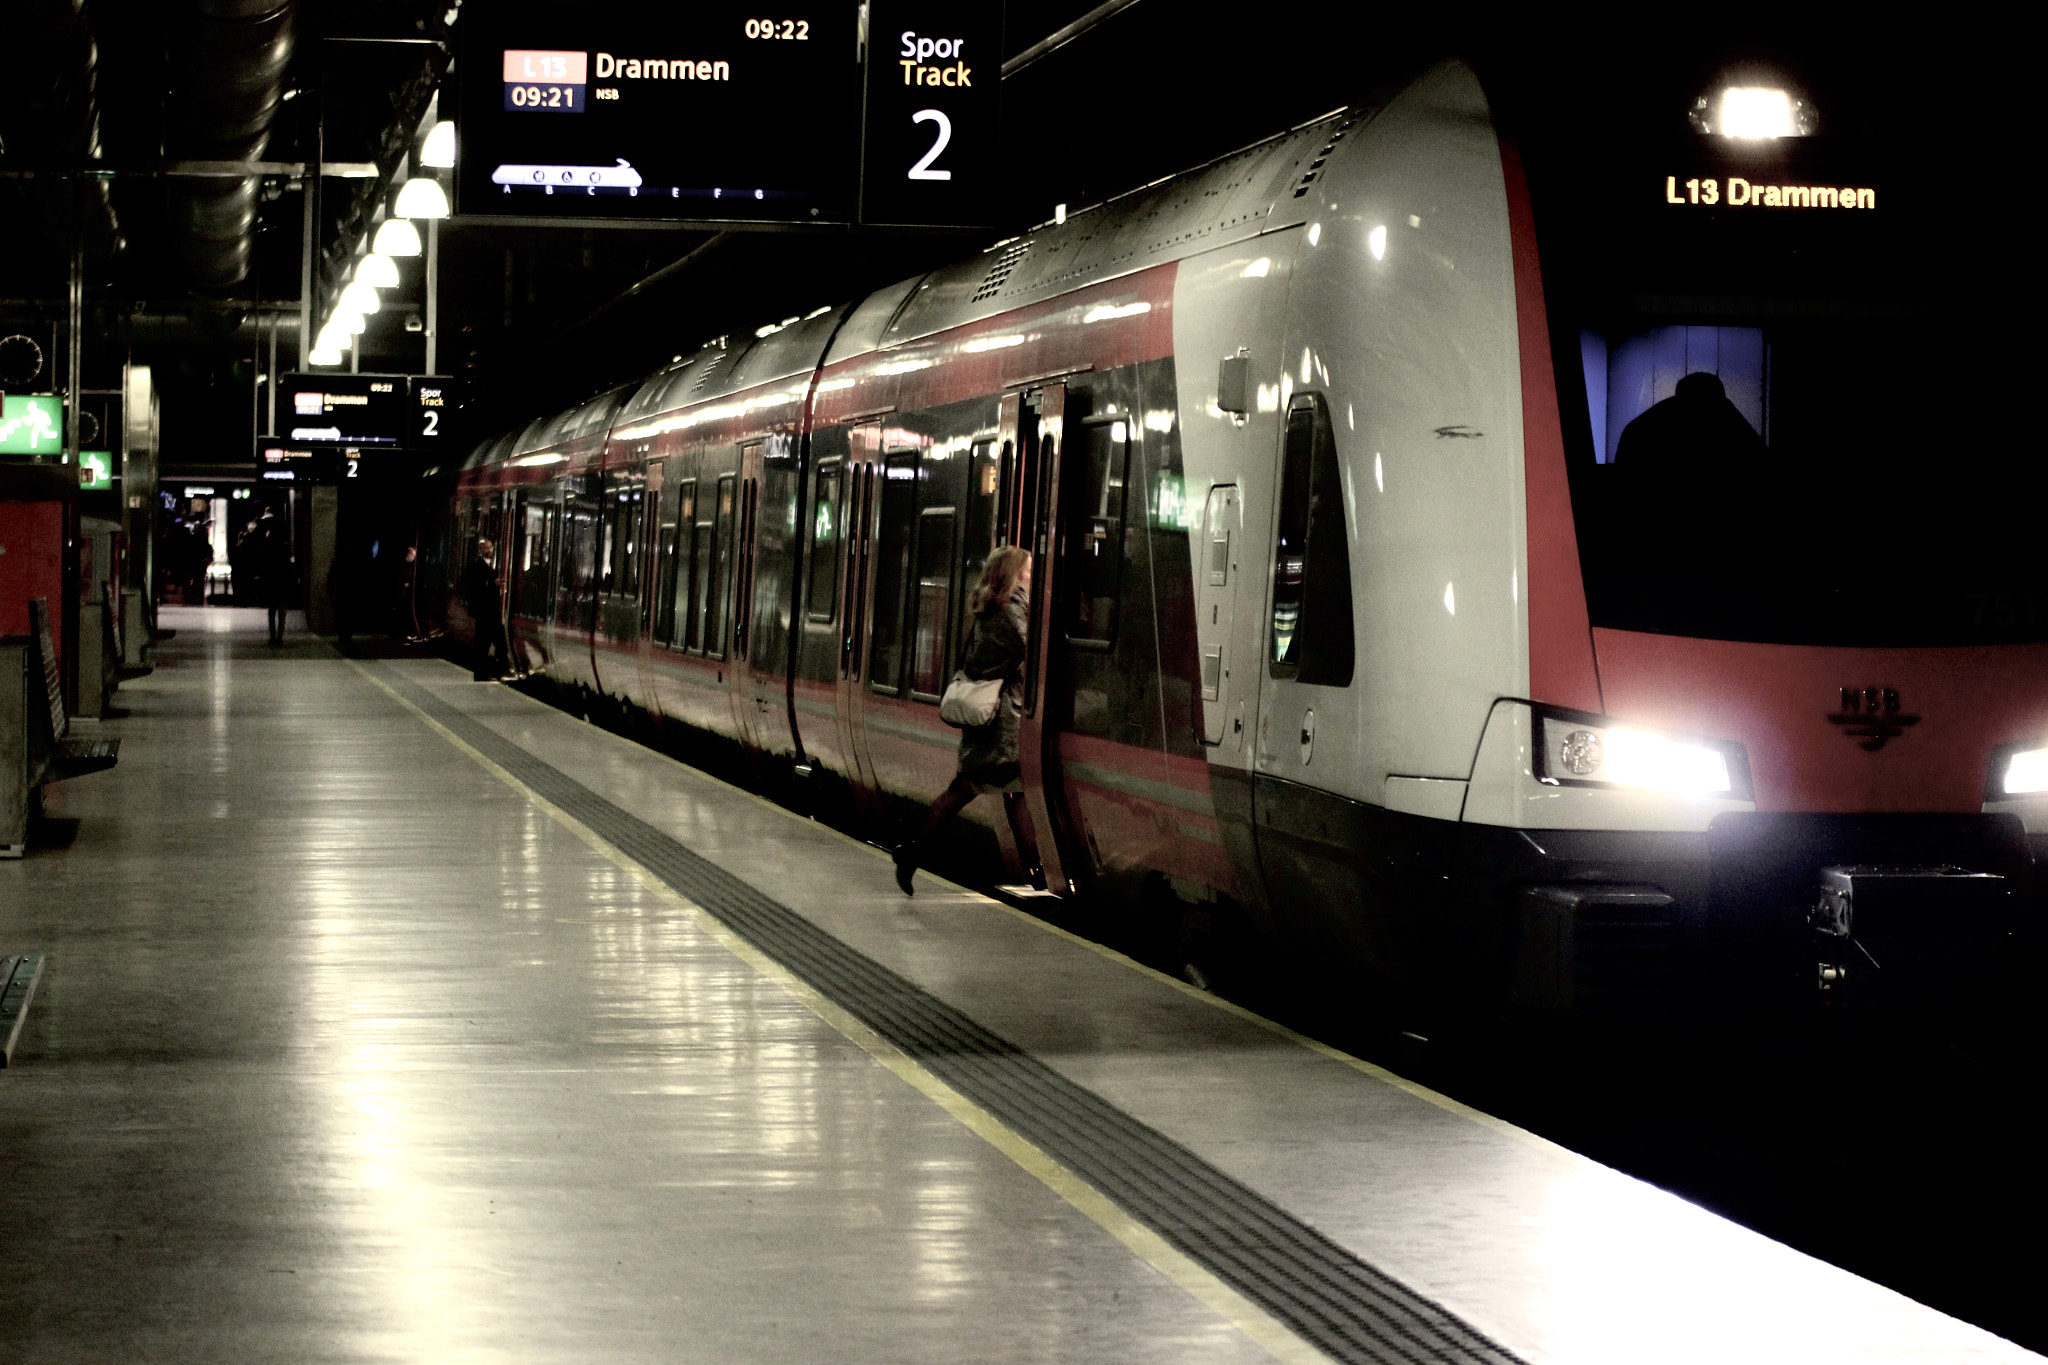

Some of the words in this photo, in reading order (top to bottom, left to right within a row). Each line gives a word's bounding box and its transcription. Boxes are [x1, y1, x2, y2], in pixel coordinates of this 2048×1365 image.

[744, 18, 809, 40] 09:22
[900, 31, 963, 63] Spor
[596, 53, 730, 81] Drammen
[900, 60, 972, 87] Track
[511, 86, 574, 108] 09:21
[595, 88, 620, 101] NSB
[908, 109, 952, 181] 2
[503, 184, 512, 194] A
[544, 185, 554, 195] B
[587, 186, 596, 196] C
[629, 187, 638, 197] D
[671, 187, 680, 198] E
[714, 187, 722, 198] F
[755, 188, 764, 199] G
[1666, 175, 1720, 205] L13
[1727, 177, 1876, 209] Drammen
[420, 387, 442, 399] Spor
[420, 397, 444, 407] Track
[423, 410, 439, 436] 2
[347, 459, 358, 478] 2
[1839, 687, 1900, 713] NSB
